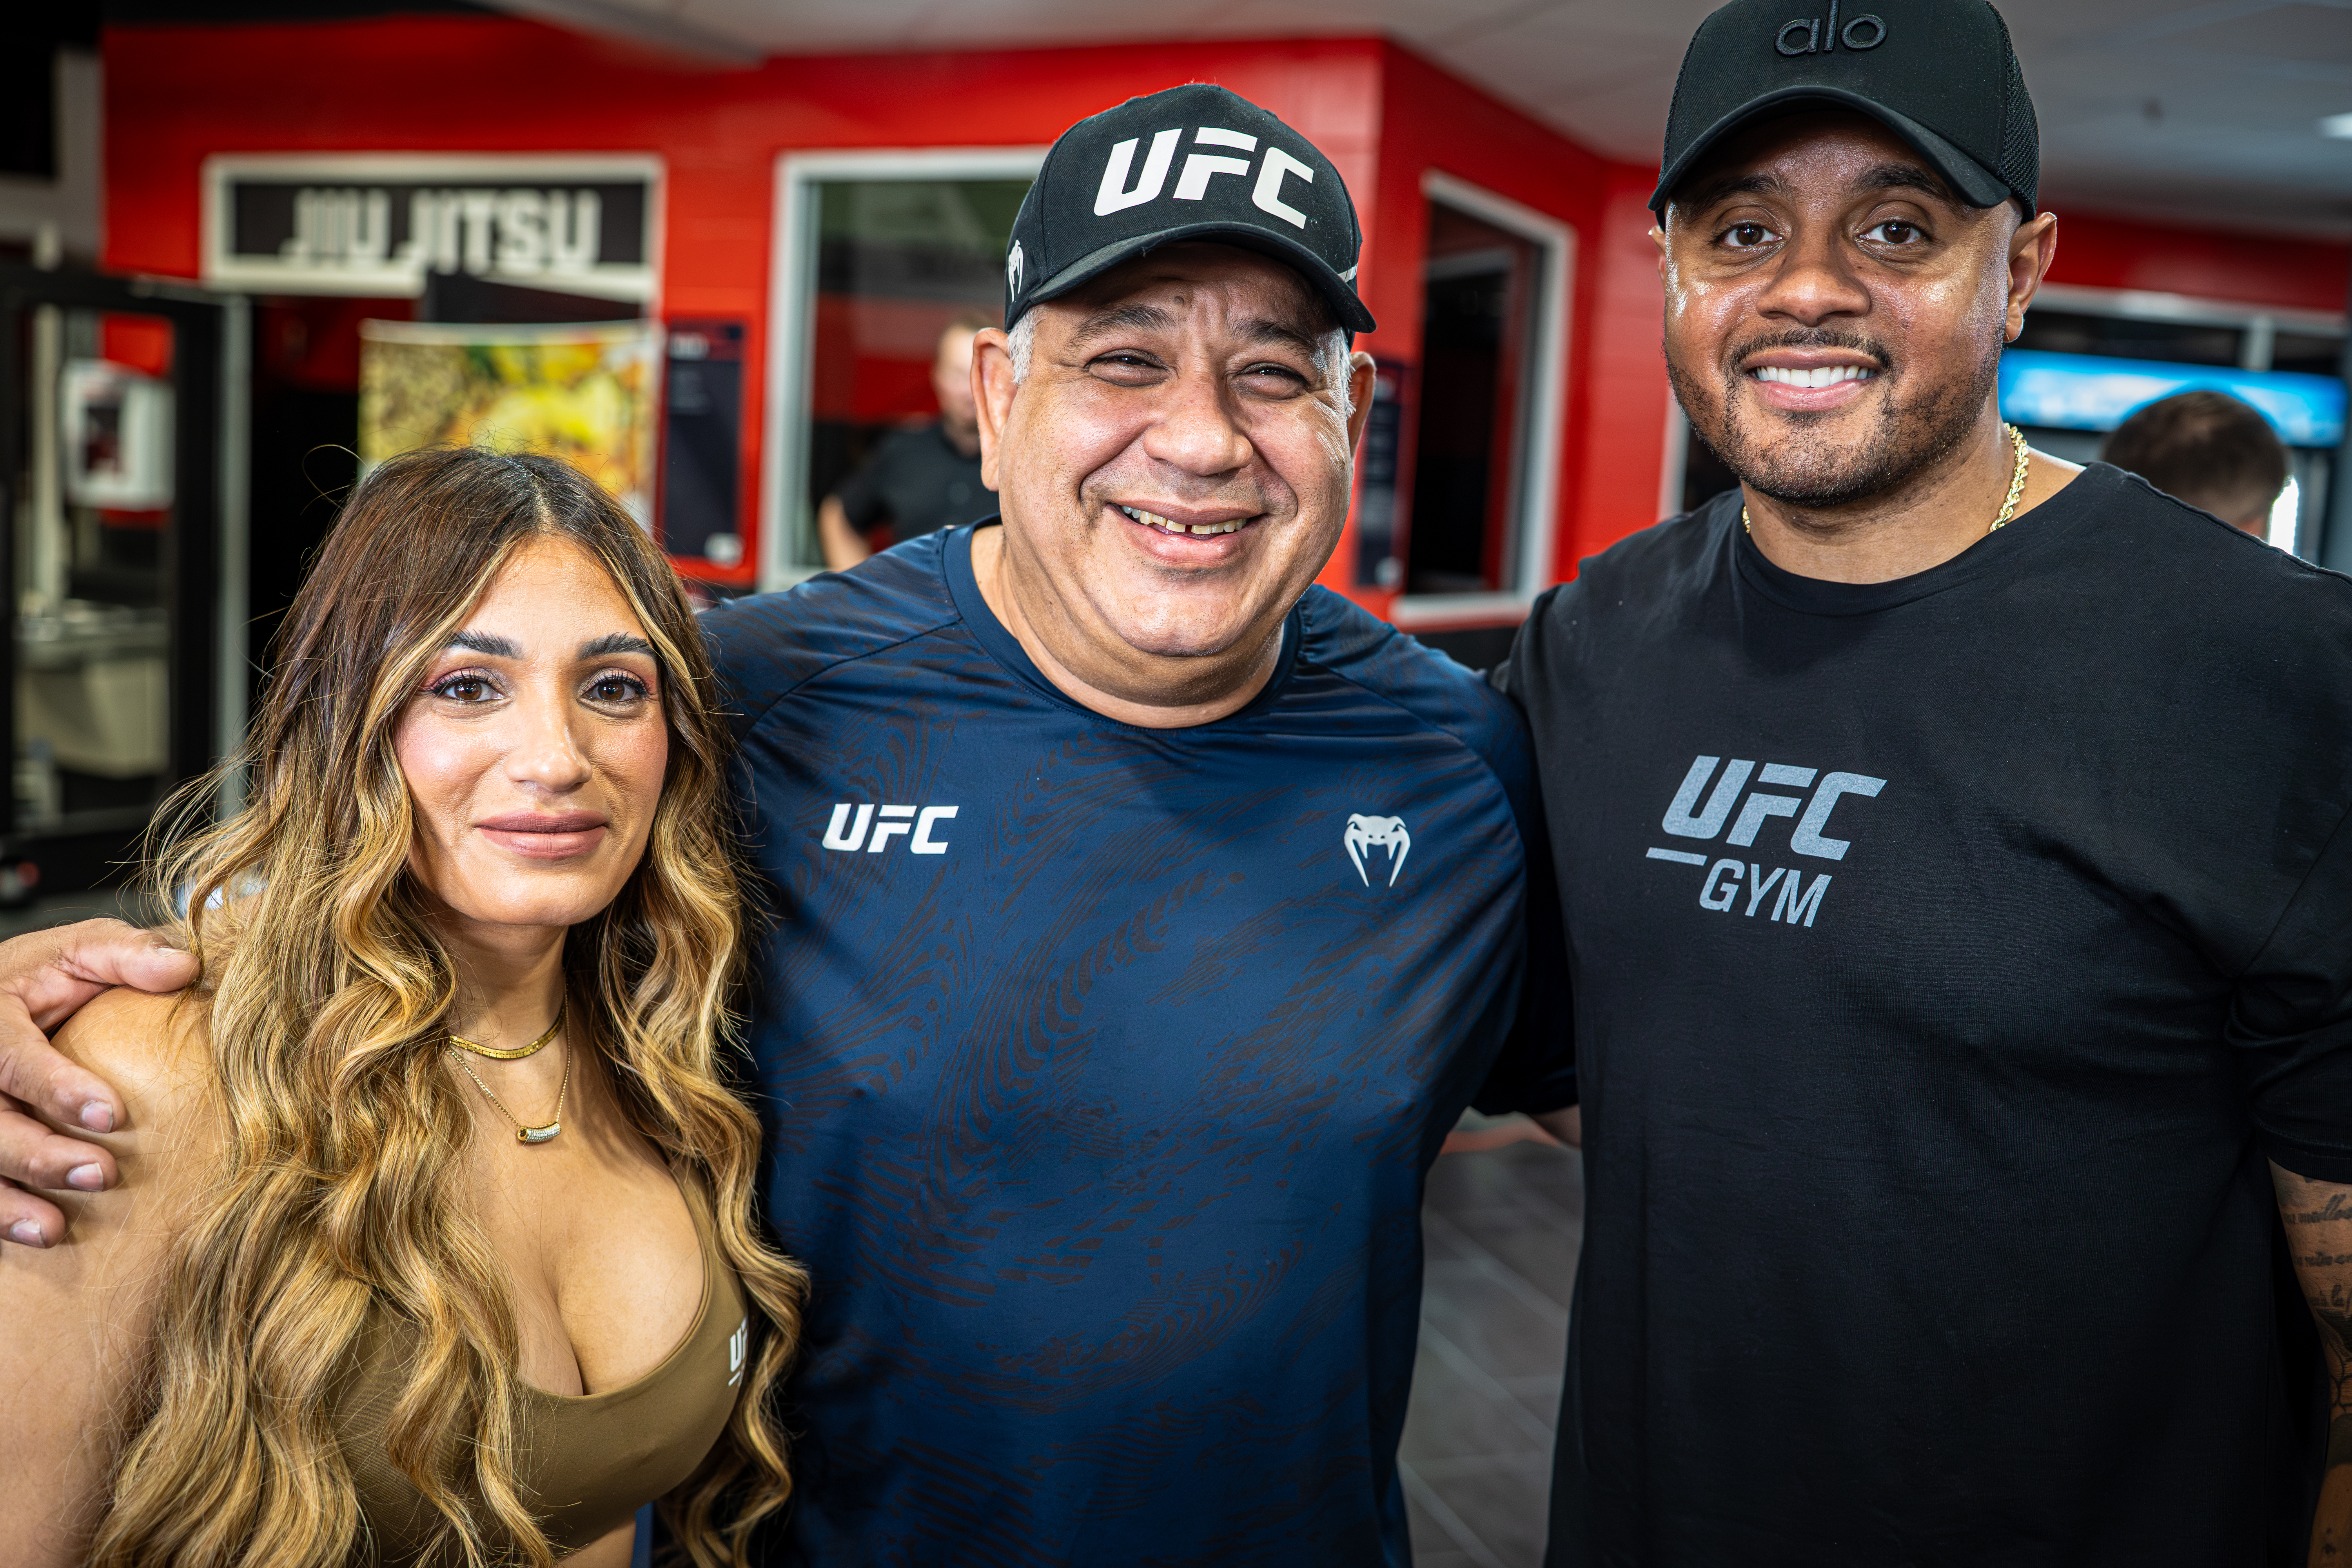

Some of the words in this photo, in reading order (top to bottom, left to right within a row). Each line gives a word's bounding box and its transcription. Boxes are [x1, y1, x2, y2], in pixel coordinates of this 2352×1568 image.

[1775, 0, 1887, 56] alo
[1094, 127, 1314, 230] UFC
[279, 187, 389, 271] JIU
[394, 187, 602, 276] JITSU
[822, 803, 959, 855] UFC
[1662, 755, 1887, 860] UFC
[1699, 858, 1832, 927] GYM
